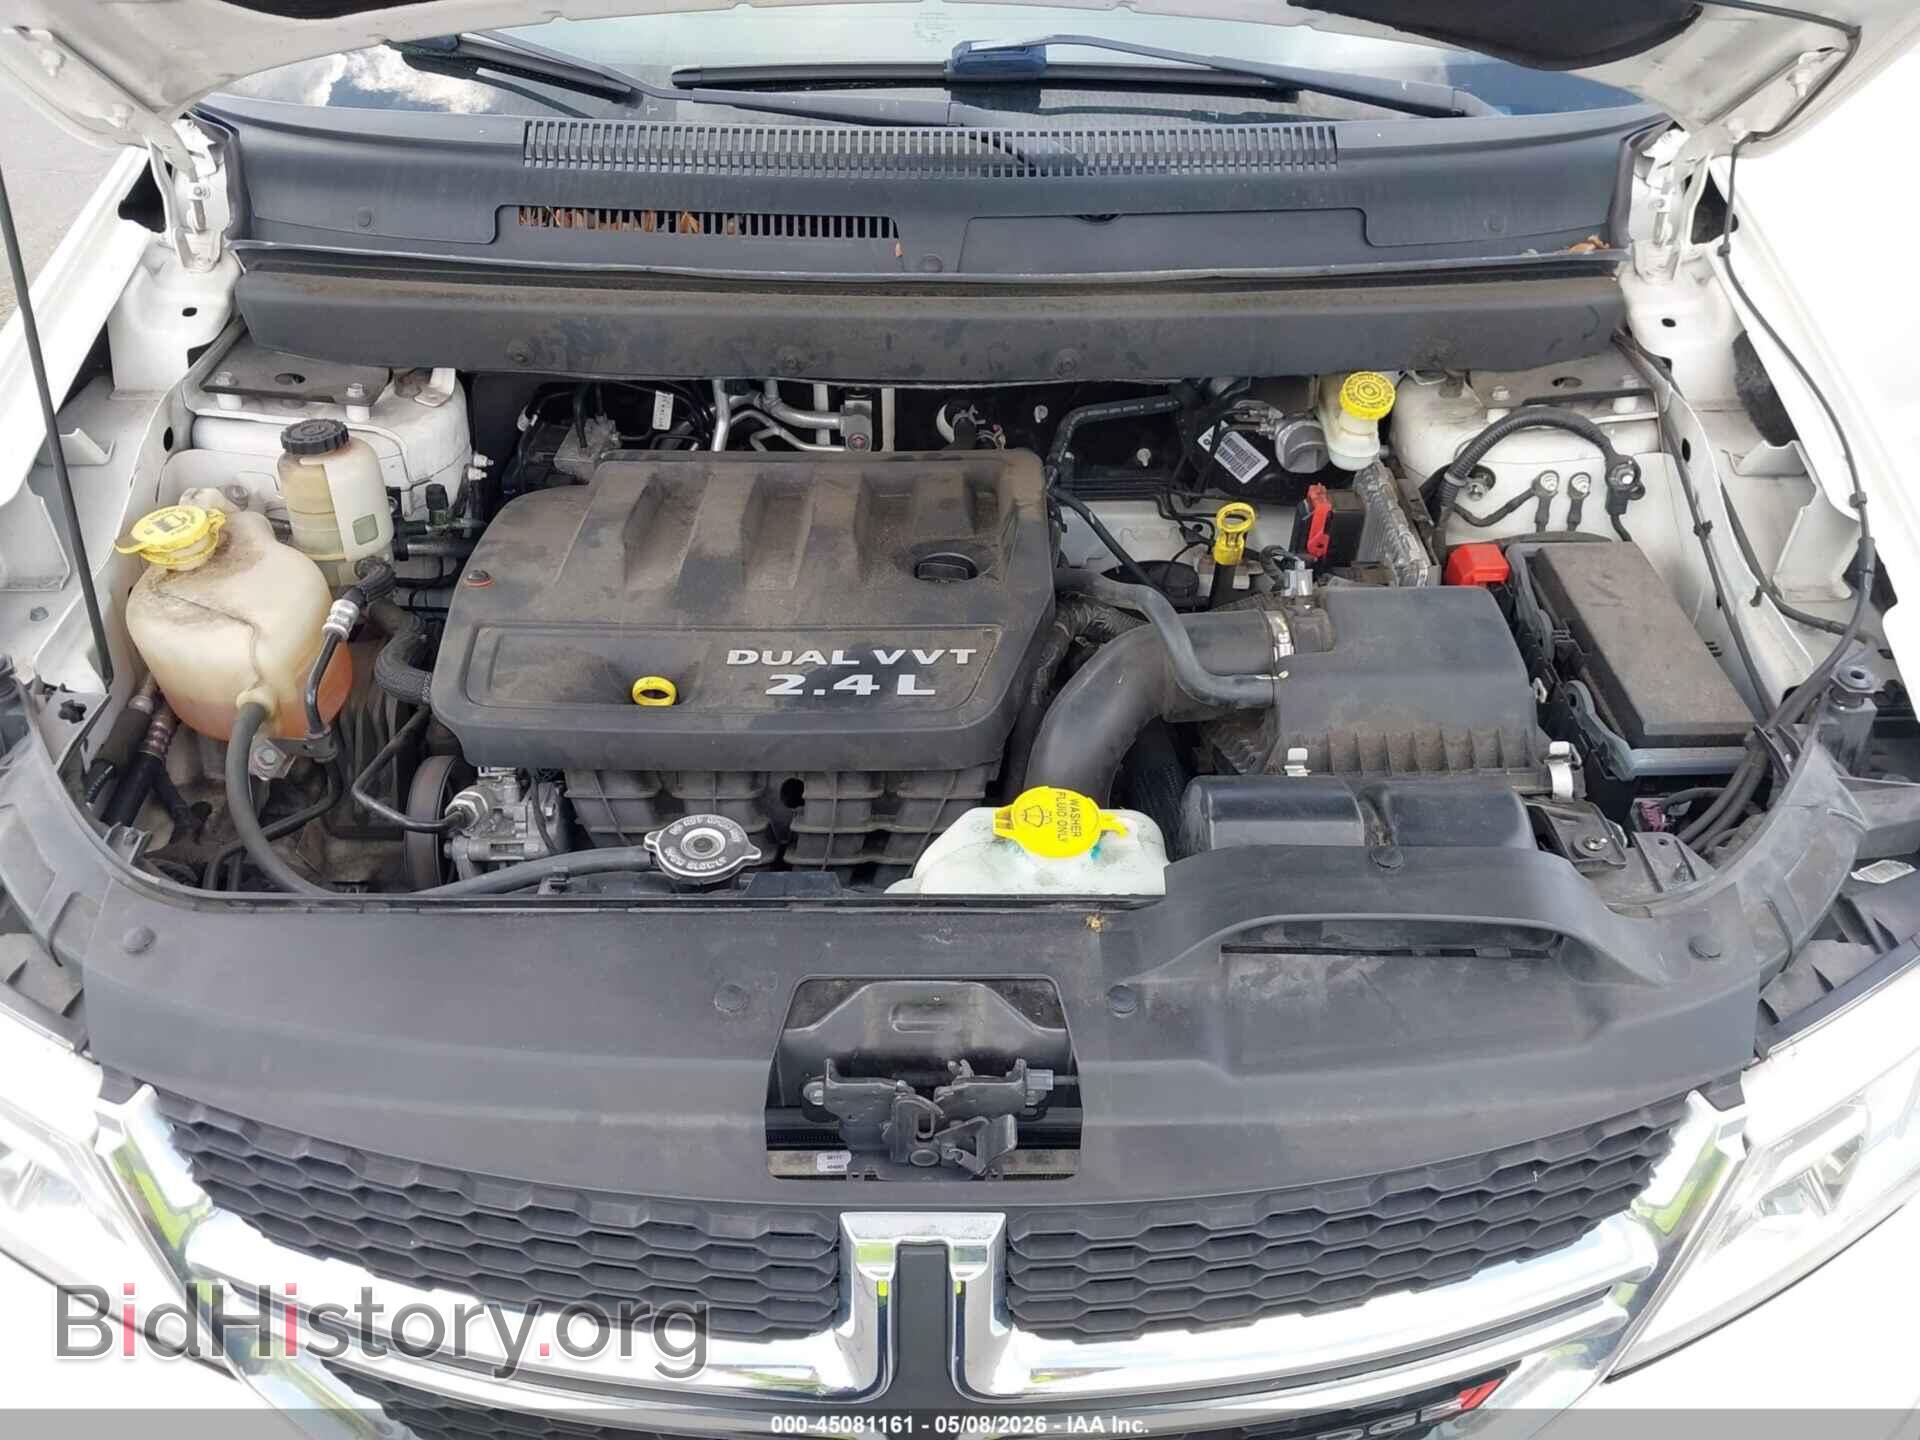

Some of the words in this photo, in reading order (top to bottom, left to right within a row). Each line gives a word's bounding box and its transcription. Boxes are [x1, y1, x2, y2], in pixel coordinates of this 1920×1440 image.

[726, 649, 861, 667] DUAL
[872, 649, 977, 666] VVT
[1055, 791, 1067, 820] FLUID
[1069, 799, 1081, 837] WASHER
